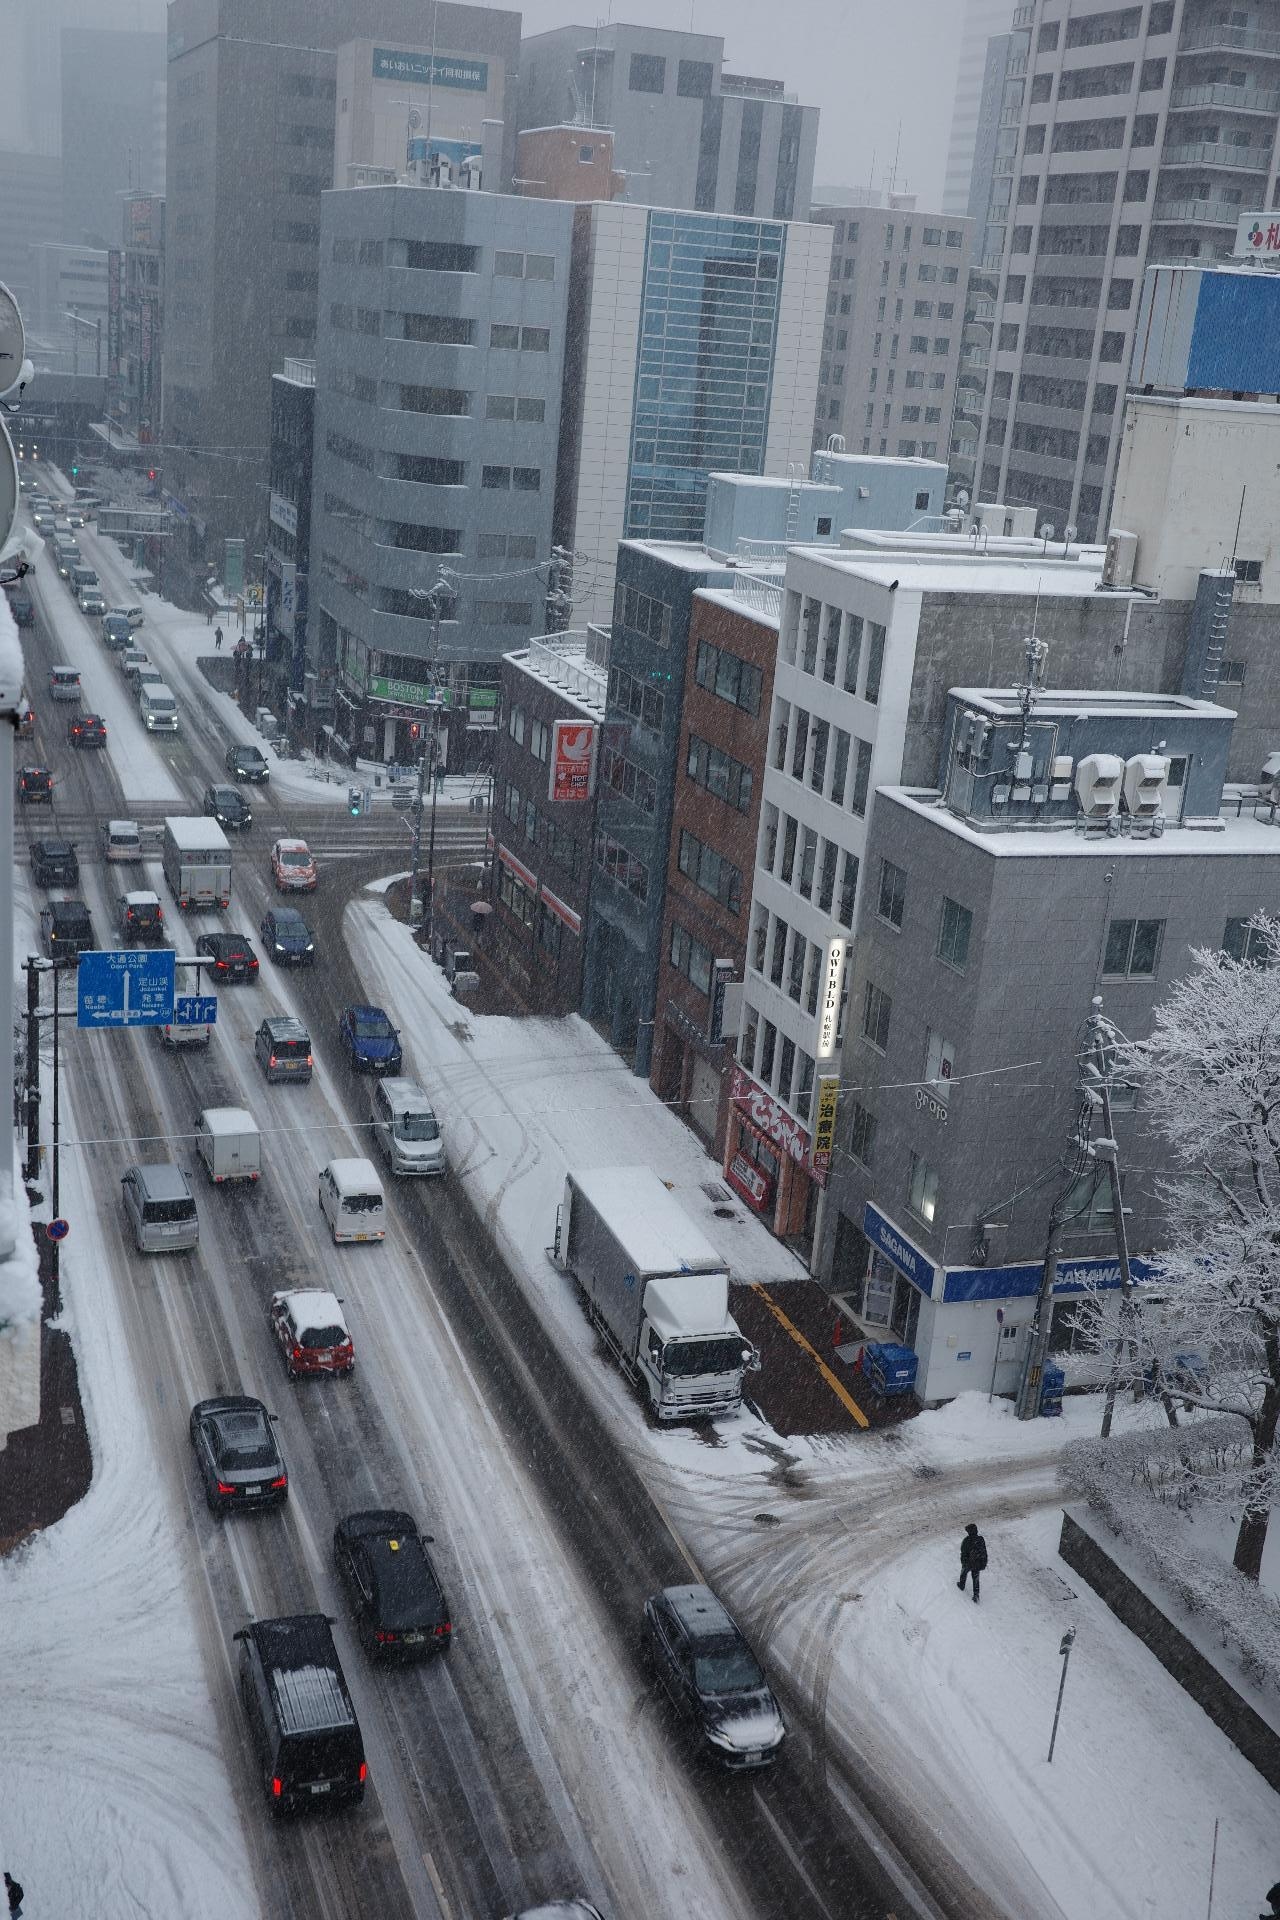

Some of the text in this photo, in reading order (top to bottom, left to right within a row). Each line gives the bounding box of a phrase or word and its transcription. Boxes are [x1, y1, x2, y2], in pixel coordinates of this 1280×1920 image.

[380, 59, 481, 81] あいおいニッセイ同和損保
[388, 681, 424, 696] BOSTON
[556, 788, 585, 799] たばこ
[107, 954, 148, 963] 大通公園
[830, 948, 840, 977] OWL
[138, 977, 168, 986] 定山渓
[826, 980, 836, 1009] BLD
[817, 1103, 834, 1150] 治療院
[880, 1226, 917, 1274] SAGAWA
